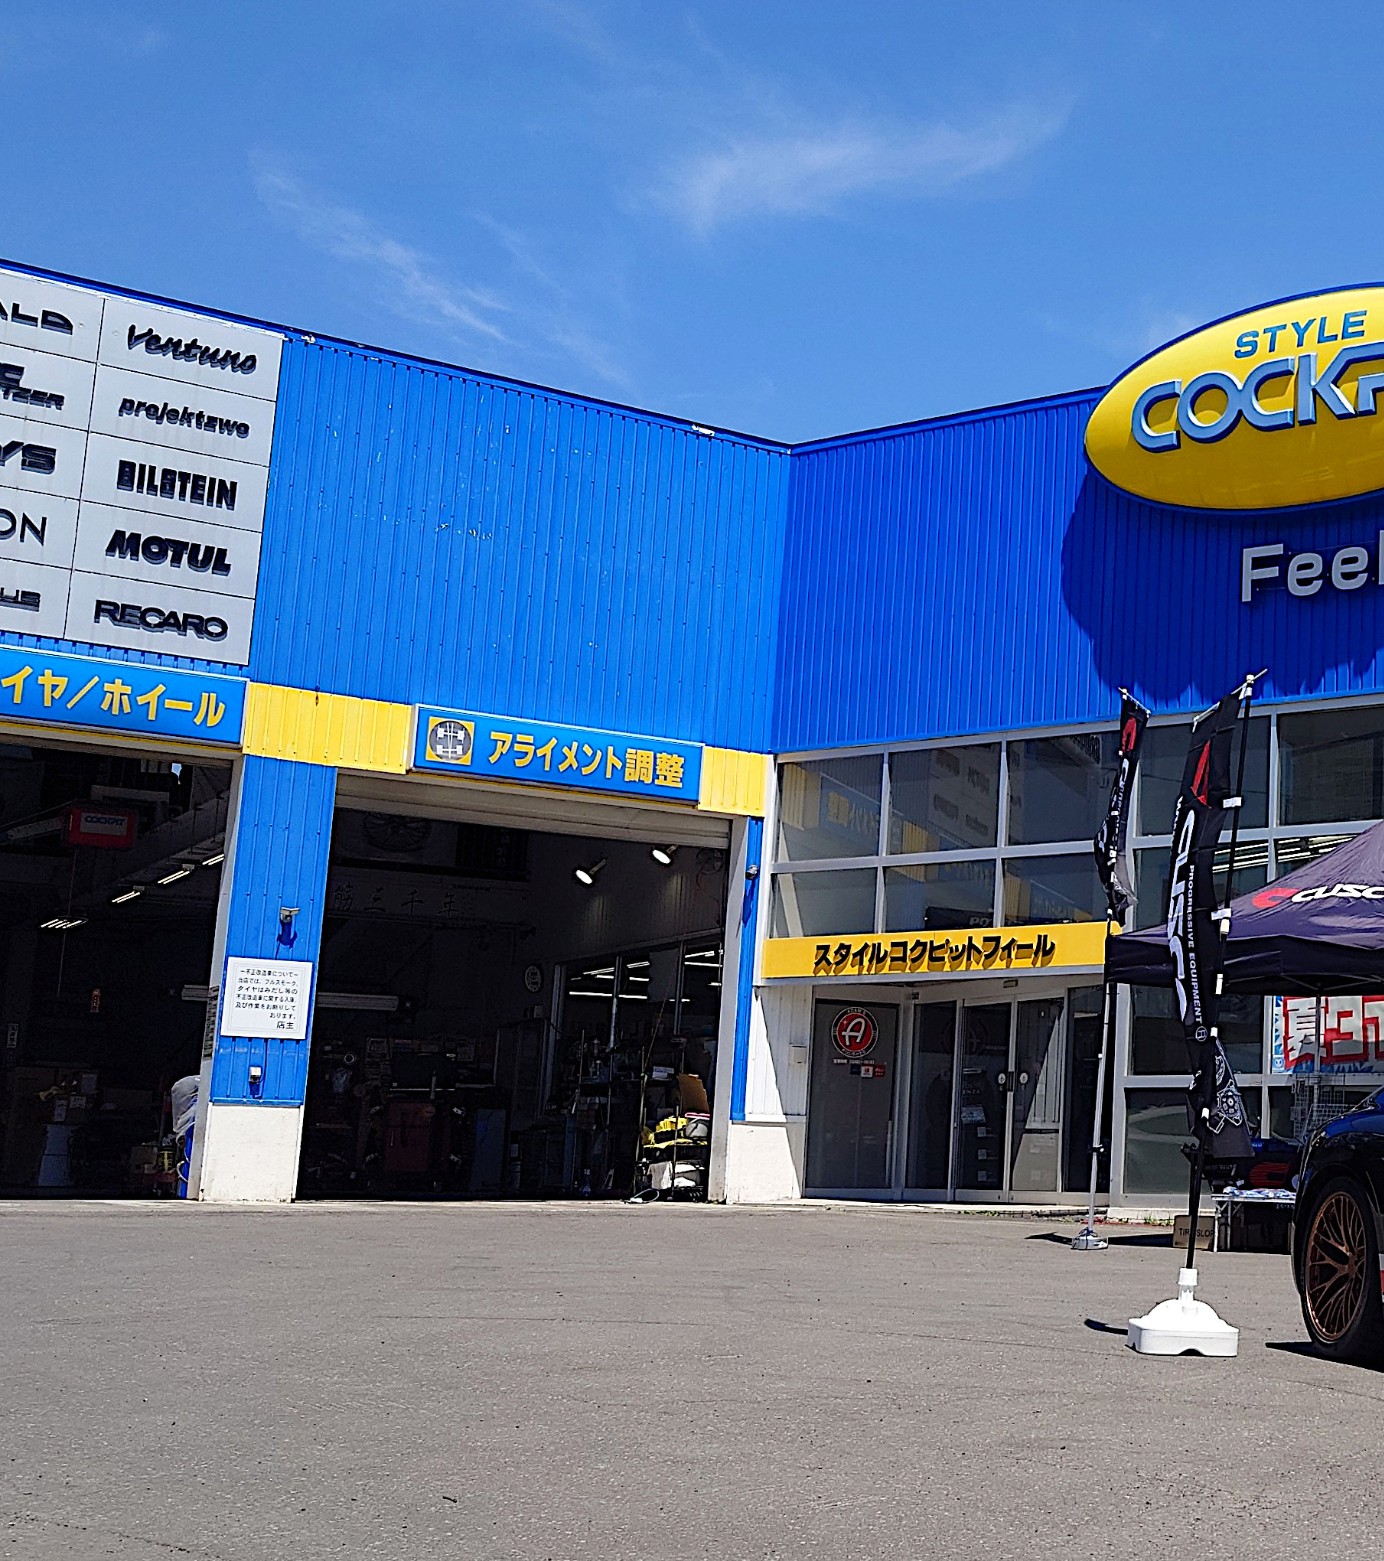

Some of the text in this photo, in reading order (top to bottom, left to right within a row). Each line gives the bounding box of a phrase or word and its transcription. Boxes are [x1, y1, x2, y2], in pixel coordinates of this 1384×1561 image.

[0, 301, 74, 336] LD
[1234, 309, 1366, 358] STYLE
[127, 324, 257, 375] Ventuno
[118, 396, 250, 438] projektzwo
[116, 459, 238, 511] BILSTEIN
[105, 529, 231, 577] MOTUL
[93, 599, 229, 642] RECARO
[488, 731, 685, 788] アライメント調整
[813, 934, 1056, 976] スタイルコクピットフィール
[1186, 864, 1202, 1024] PROGRESSIVE EQUIPMENT
[276, 1020, 294, 1030] 店主
